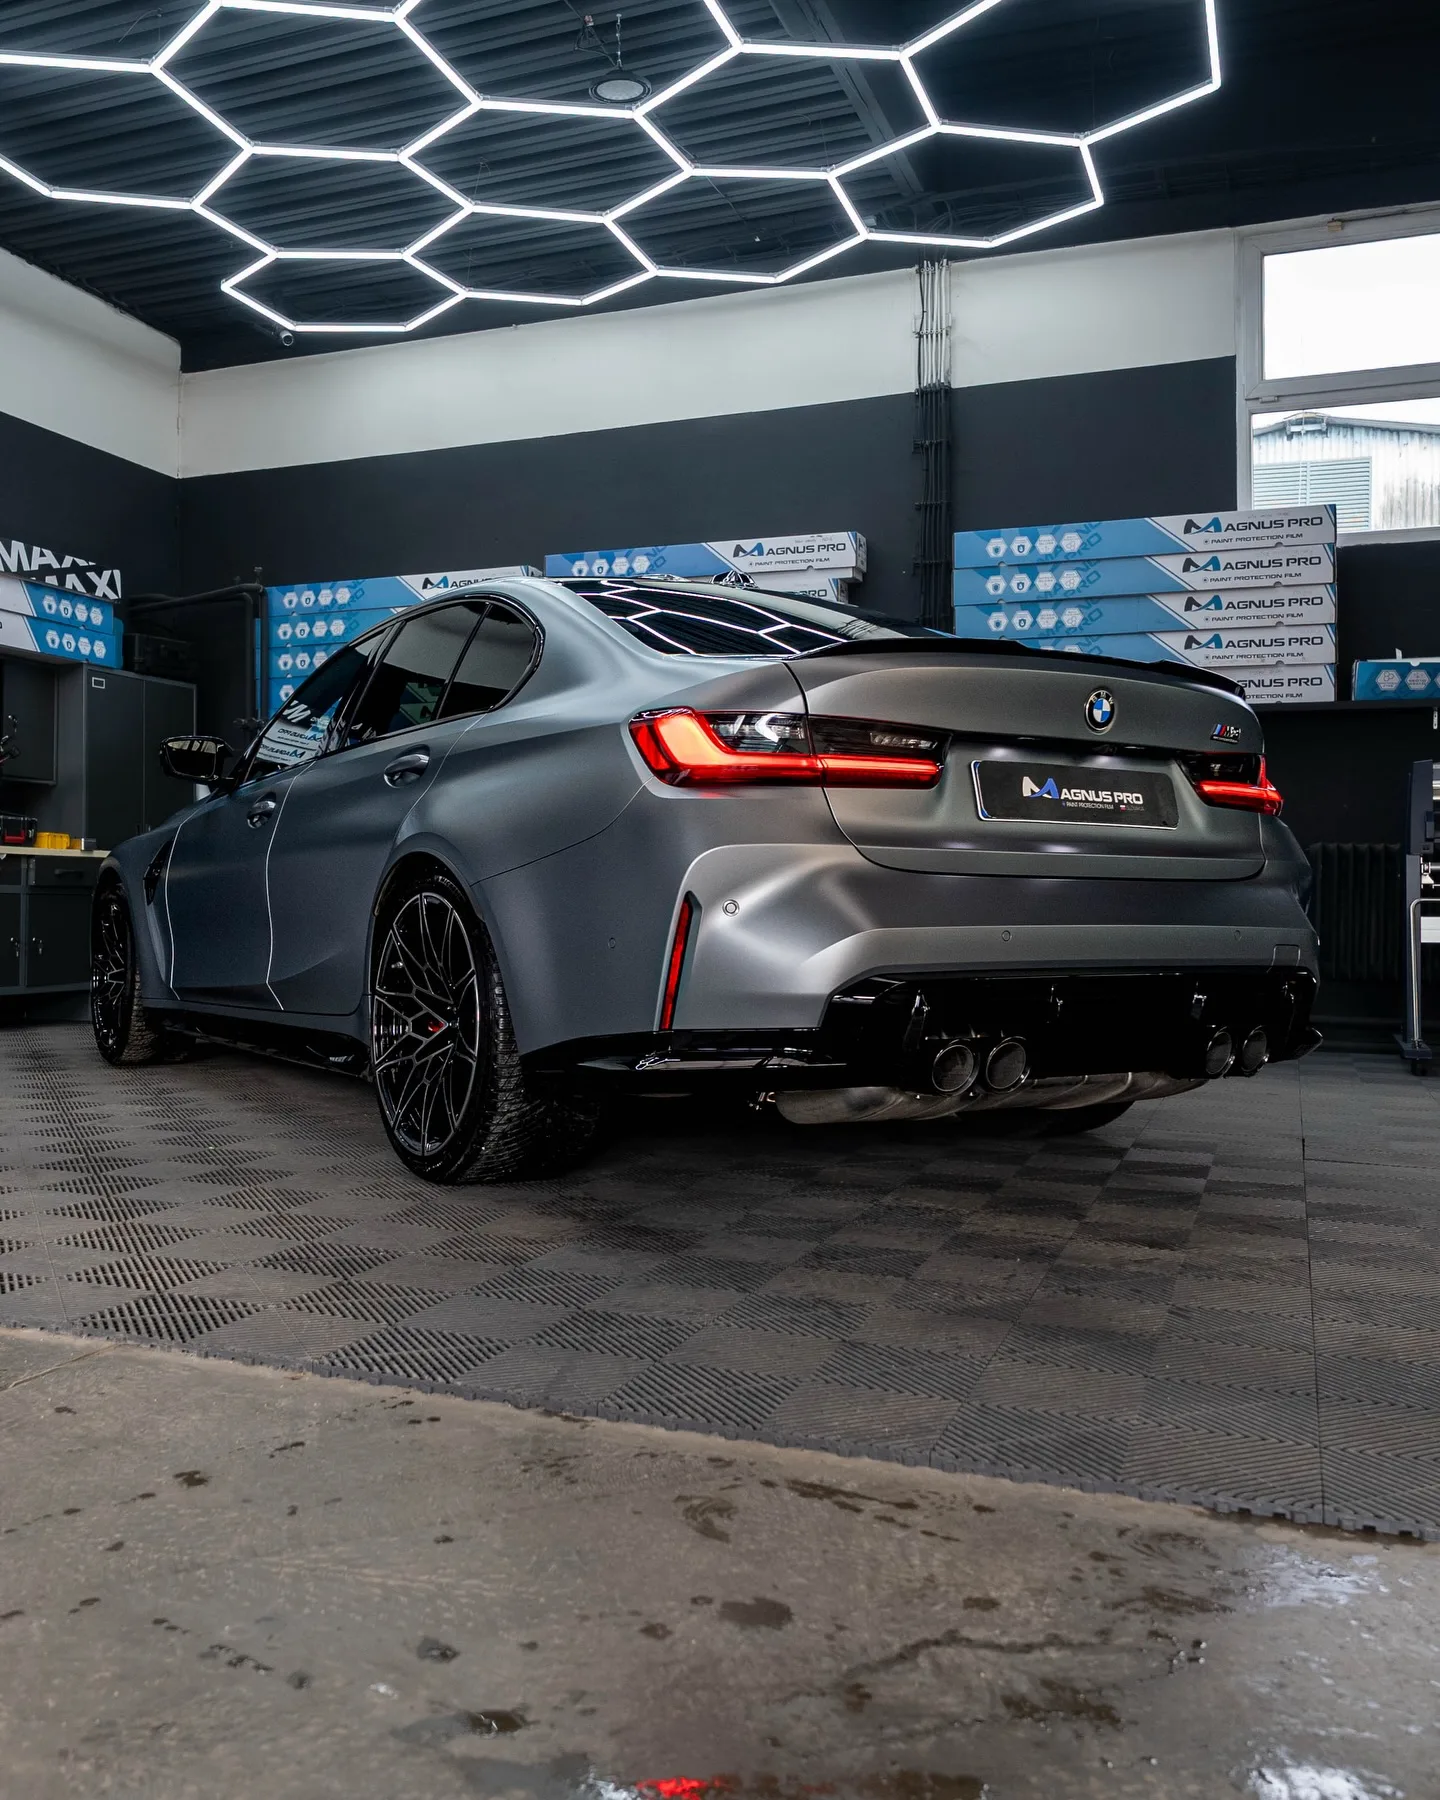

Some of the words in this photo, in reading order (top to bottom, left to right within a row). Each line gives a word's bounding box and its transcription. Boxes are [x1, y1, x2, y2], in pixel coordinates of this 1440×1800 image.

[1183, 517, 1284, 535] MAGNUS
[1287, 516, 1323, 528] PRO
[1236, 534, 1284, 542] PROTECTION
[733, 542, 815, 558] MAGNUS
[817, 543, 846, 553] PRO
[1182, 556, 1283, 573] MAGNUS
[1286, 556, 1322, 567] PRO
[1234, 573, 1283, 581] PROTECTION
[1184, 595, 1285, 612] MAGNUS
[1288, 596, 1323, 607] PRO
[1236, 613, 1284, 621] PROTECTION
[1184, 633, 1285, 650] MAGNUS
[1288, 636, 1324, 646] PRO
[1237, 678, 1284, 688] GNUS
[1287, 677, 1323, 686] PRO
[1022, 776, 1113, 803] MAGNUS
[1114, 792, 1143, 805] PRO
